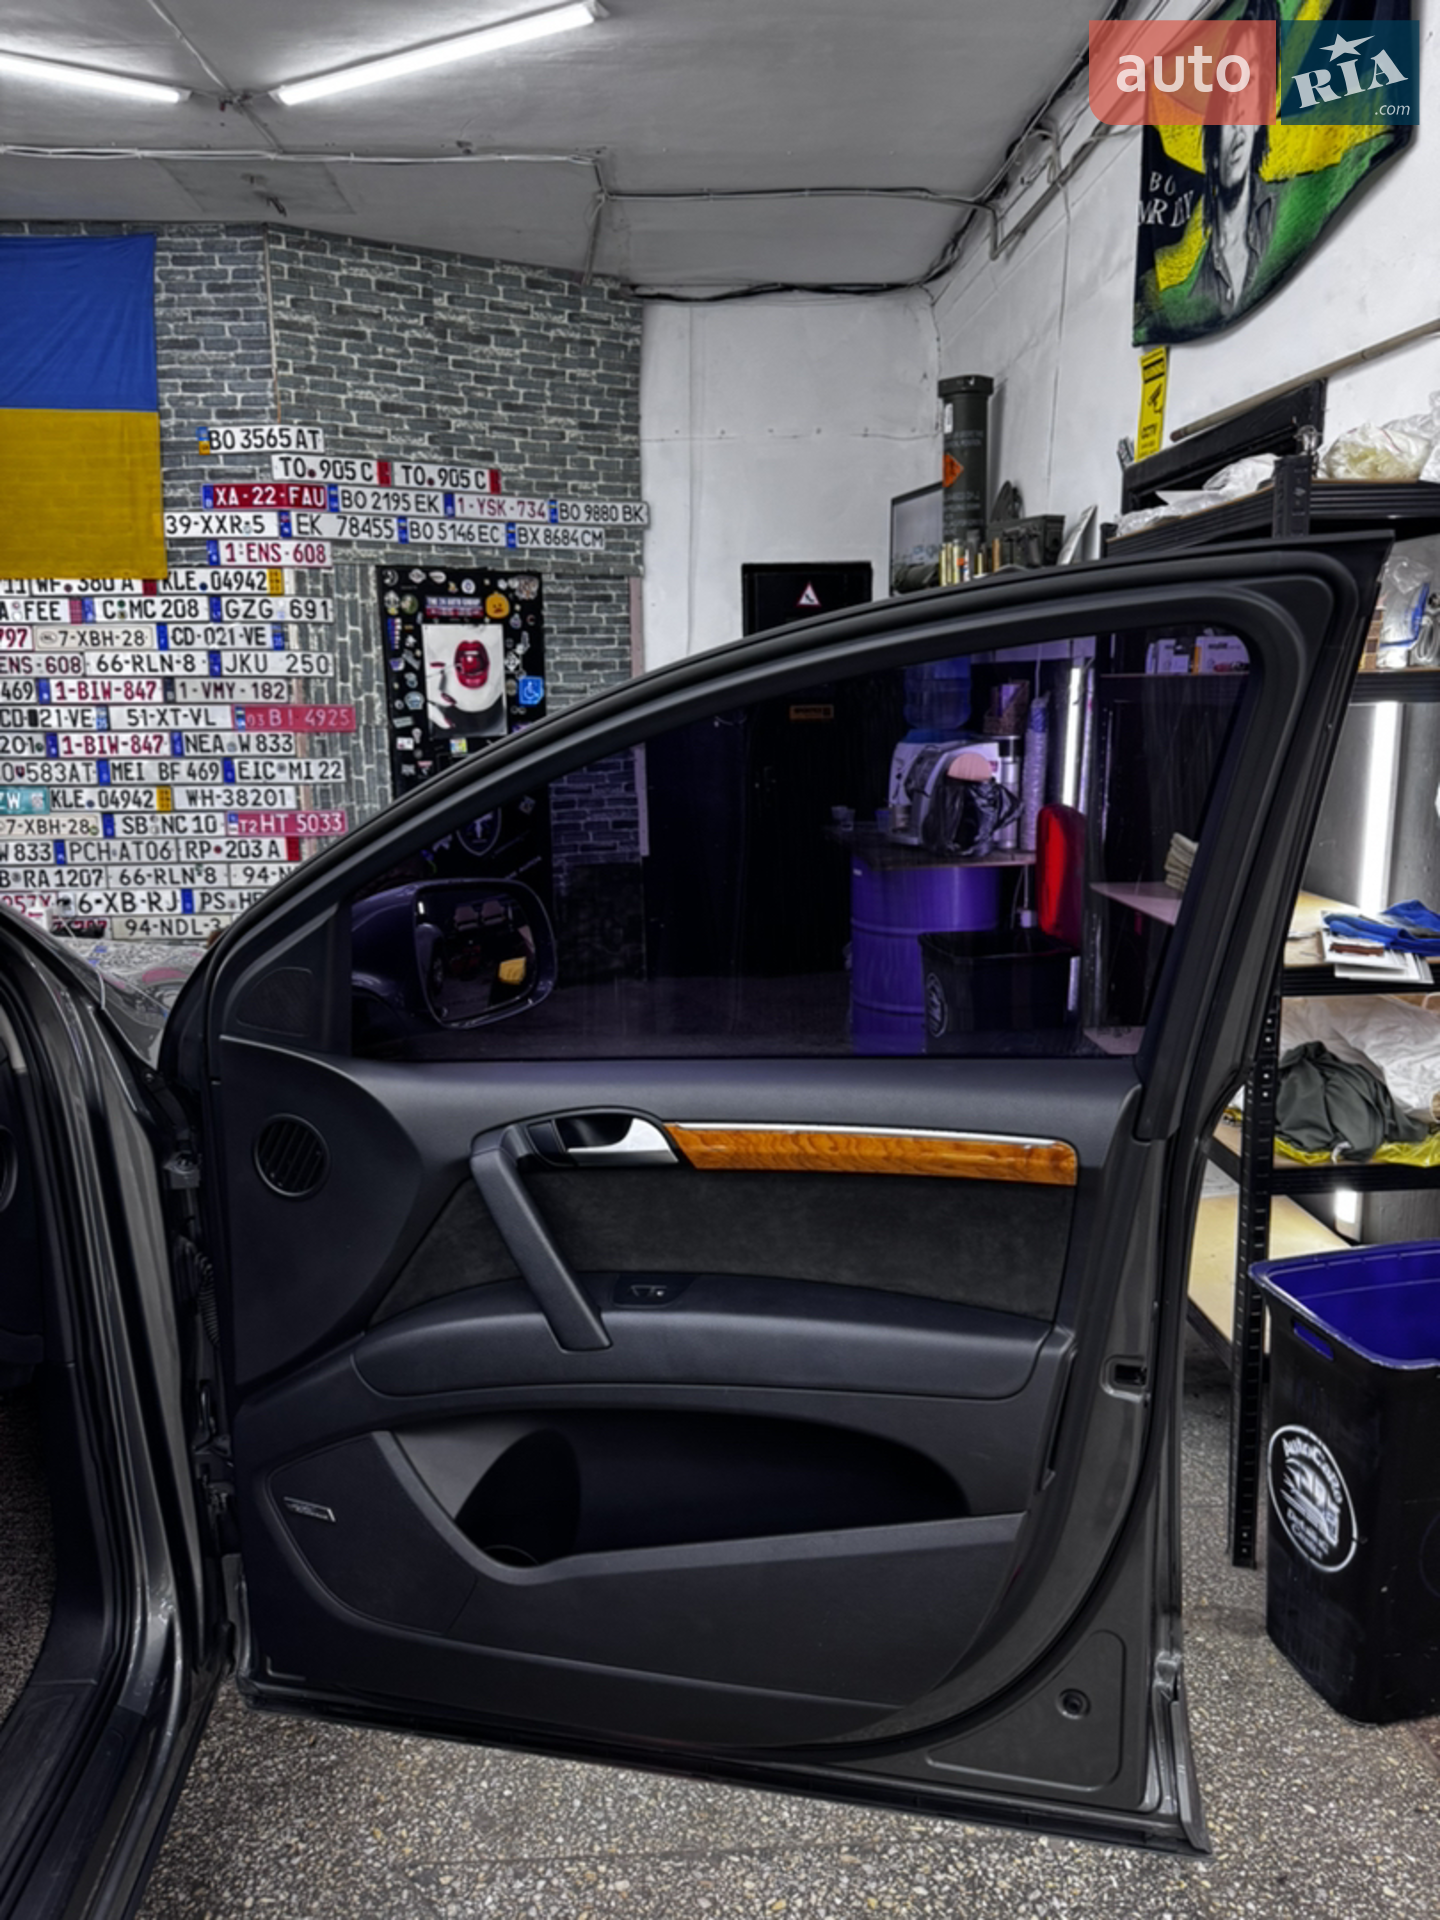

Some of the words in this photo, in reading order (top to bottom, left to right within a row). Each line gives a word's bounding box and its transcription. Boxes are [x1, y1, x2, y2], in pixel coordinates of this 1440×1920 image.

[208, 429, 236, 450] BO
[240, 428, 292, 449] 3565
[296, 428, 320, 450] AT
[279, 456, 306, 479] TO
[319, 459, 356, 481] 905
[360, 461, 374, 482] C
[400, 465, 426, 486] TO
[437, 467, 471, 489] 905
[474, 470, 487, 490] C
[341, 489, 367, 510] BO
[371, 492, 412, 512] 2195
[415, 494, 440, 514] EK
[559, 502, 580, 522] BO
[584, 503, 619, 523] 9880
[622, 505, 645, 523] BK
[296, 513, 323, 536] EK
[336, 515, 395, 538] 78455
[410, 521, 434, 540] BO
[438, 522, 476, 542] 5146
[478, 524, 501, 543] EC
[518, 526, 541, 545] BX
[544, 528, 579, 547] 8684
[581, 529, 604, 548] CM
[162, 570, 197, 591] KLE
[210, 570, 268, 591] 04942
[24, 601, 61, 621] FEE
[103, 599, 116, 620] C
[129, 599, 157, 620] MC
[160, 599, 200, 619] 208
[225, 598, 274, 620] GZG
[289, 599, 329, 620] 691
[58, 629, 146, 647] 7-XBH-28
[96, 653, 196, 674] 66-RLN-8
[225, 655, 269, 673] JKU
[285, 654, 330, 675] 250
[1, 681, 34, 701] 469
[55, 680, 157, 701] 1-BIW-847
[305, 708, 351, 727] 4925
[62, 734, 164, 755] 1-BIW-847
[184, 733, 225, 753] NEA
[237, 734, 251, 753] W
[255, 733, 294, 753] 833
[111, 762, 145, 781] MEI
[158, 762, 181, 781] BF
[186, 762, 220, 781] 469
[237, 761, 277, 780] EIC
[288, 761, 314, 780] MI
[318, 760, 342, 780] 22
[51, 789, 85, 809] KLE
[97, 789, 154, 809] 04942
[186, 788, 287, 807] WH-38201
[6, 818, 90, 835] 7-XBH-28
[122, 815, 148, 835] SB
[161, 815, 188, 835] NC
[191, 815, 218, 835] 10
[260, 814, 288, 833] HT
[296, 813, 343, 832] 5033
[14, 843, 52, 862] 833
[69, 841, 111, 861] PCH
[119, 841, 172, 861] AT06
[185, 840, 211, 859] RP
[225, 840, 263, 859] 203
[268, 839, 281, 859] A
[24, 869, 50, 888] RA
[54, 868, 103, 888] 1207
[199, 891, 226, 911] PS
